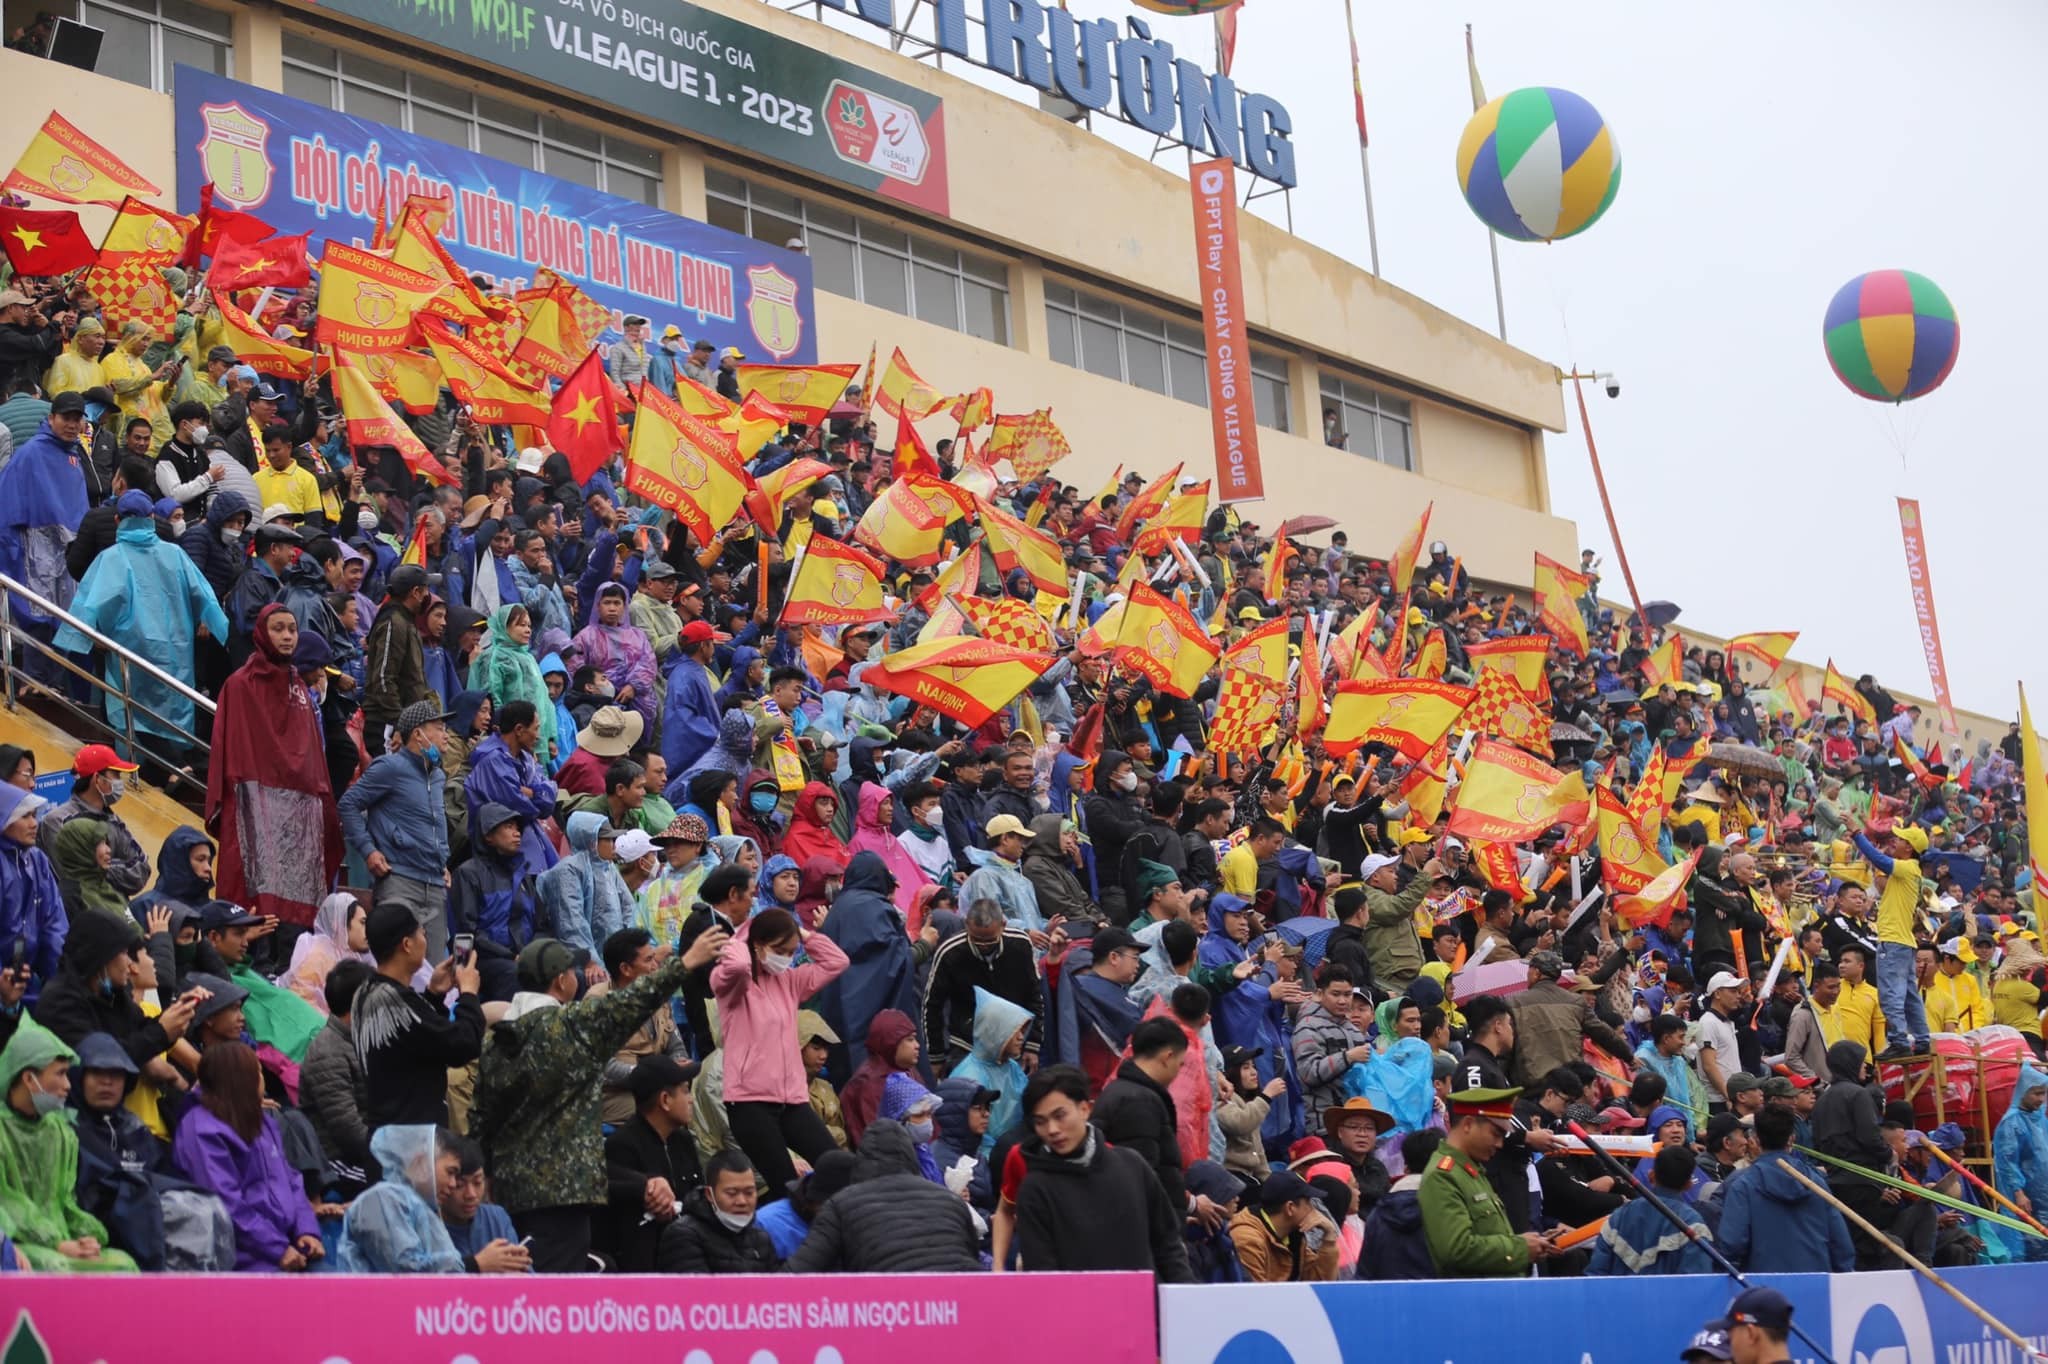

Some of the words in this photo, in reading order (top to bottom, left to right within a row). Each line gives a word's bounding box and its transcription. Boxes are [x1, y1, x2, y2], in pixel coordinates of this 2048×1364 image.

[622, 7, 665, 40] ĐỊCH
[669, 26, 721, 60] QUỐC
[725, 46, 756, 73] GIA
[544, 15, 699, 99] V.LEAGUE
[704, 72, 721, 106] 1
[742, 84, 814, 137] 2023
[292, 137, 341, 216] HỘI
[346, 142, 384, 221] CỔ
[461, 187, 516, 259] VIÊN
[521, 206, 586, 278] BÓNG
[591, 224, 624, 288] ĐÁ
[626, 237, 678, 304] NAM
[681, 254, 736, 325] ĐỊNH
[1206, 196, 1223, 231] FPT
[1207, 233, 1223, 280] Play
[1217, 343, 1237, 400] CÙNG
[1224, 403, 1247, 488] V.LEAGUE
[416, 1297, 487, 1336] NƯỚC
[492, 1293, 563, 1335] UỐNG
[567, 1297, 650, 1334] DƯỠNG
[655, 1304, 686, 1333] DA
[689, 1301, 802, 1331] COLLAGEN
[807, 1295, 850, 1329] SÂM
[854, 1300, 910, 1333] NGỌC
[914, 1299, 959, 1327] LINH
